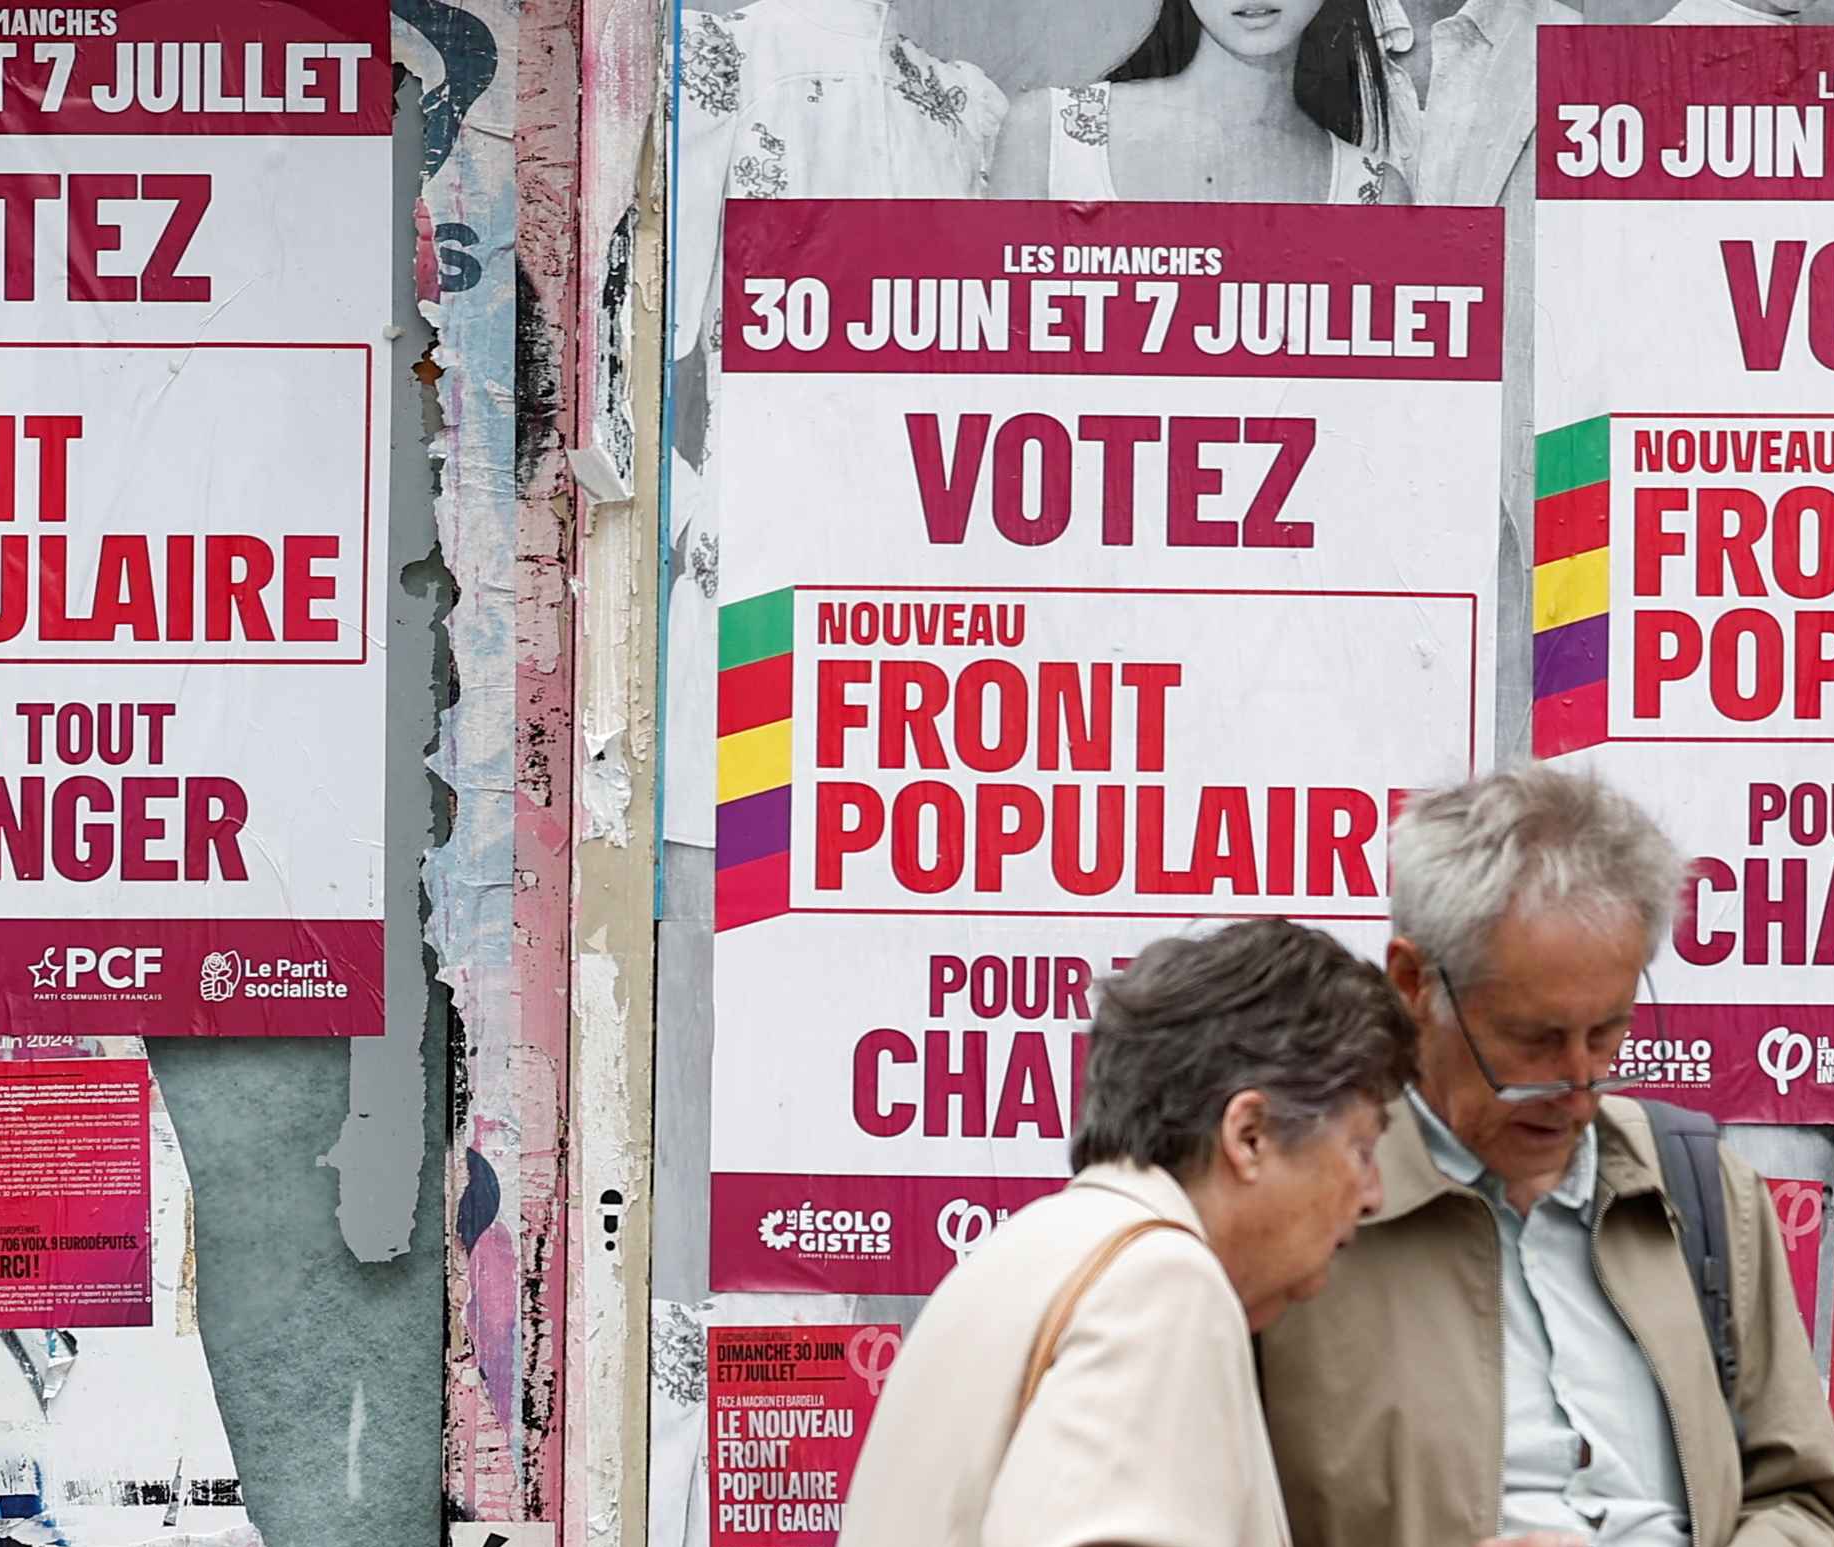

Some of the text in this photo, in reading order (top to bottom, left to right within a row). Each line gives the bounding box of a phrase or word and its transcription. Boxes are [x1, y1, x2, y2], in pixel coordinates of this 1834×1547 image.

[39, 41, 77, 112] 7
[92, 41, 370, 112] JUILLET
[1557, 104, 1643, 177] 30
[1662, 106, 1823, 177] JUIN
[1005, 246, 1221, 275] LES DIMANCHES
[743, 278, 1482, 357] 30 JUIN ET 7 JUILLET
[905, 413, 1316, 548] VOTEZ
[818, 602, 1025, 647] NOUVEAU
[16, 703, 175, 765] TOUT
[817, 659, 1181, 772] FRONT
[815, 780, 1407, 897] POPULAIR
[67, 947, 162, 988] PCF
[245, 959, 327, 977] Le Parti
[245, 979, 347, 997] socialiste
[930, 955, 1090, 1019] POUR
[799, 1202, 890, 1232] ÉCOLO
[799, 1229, 890, 1252] GISTES
